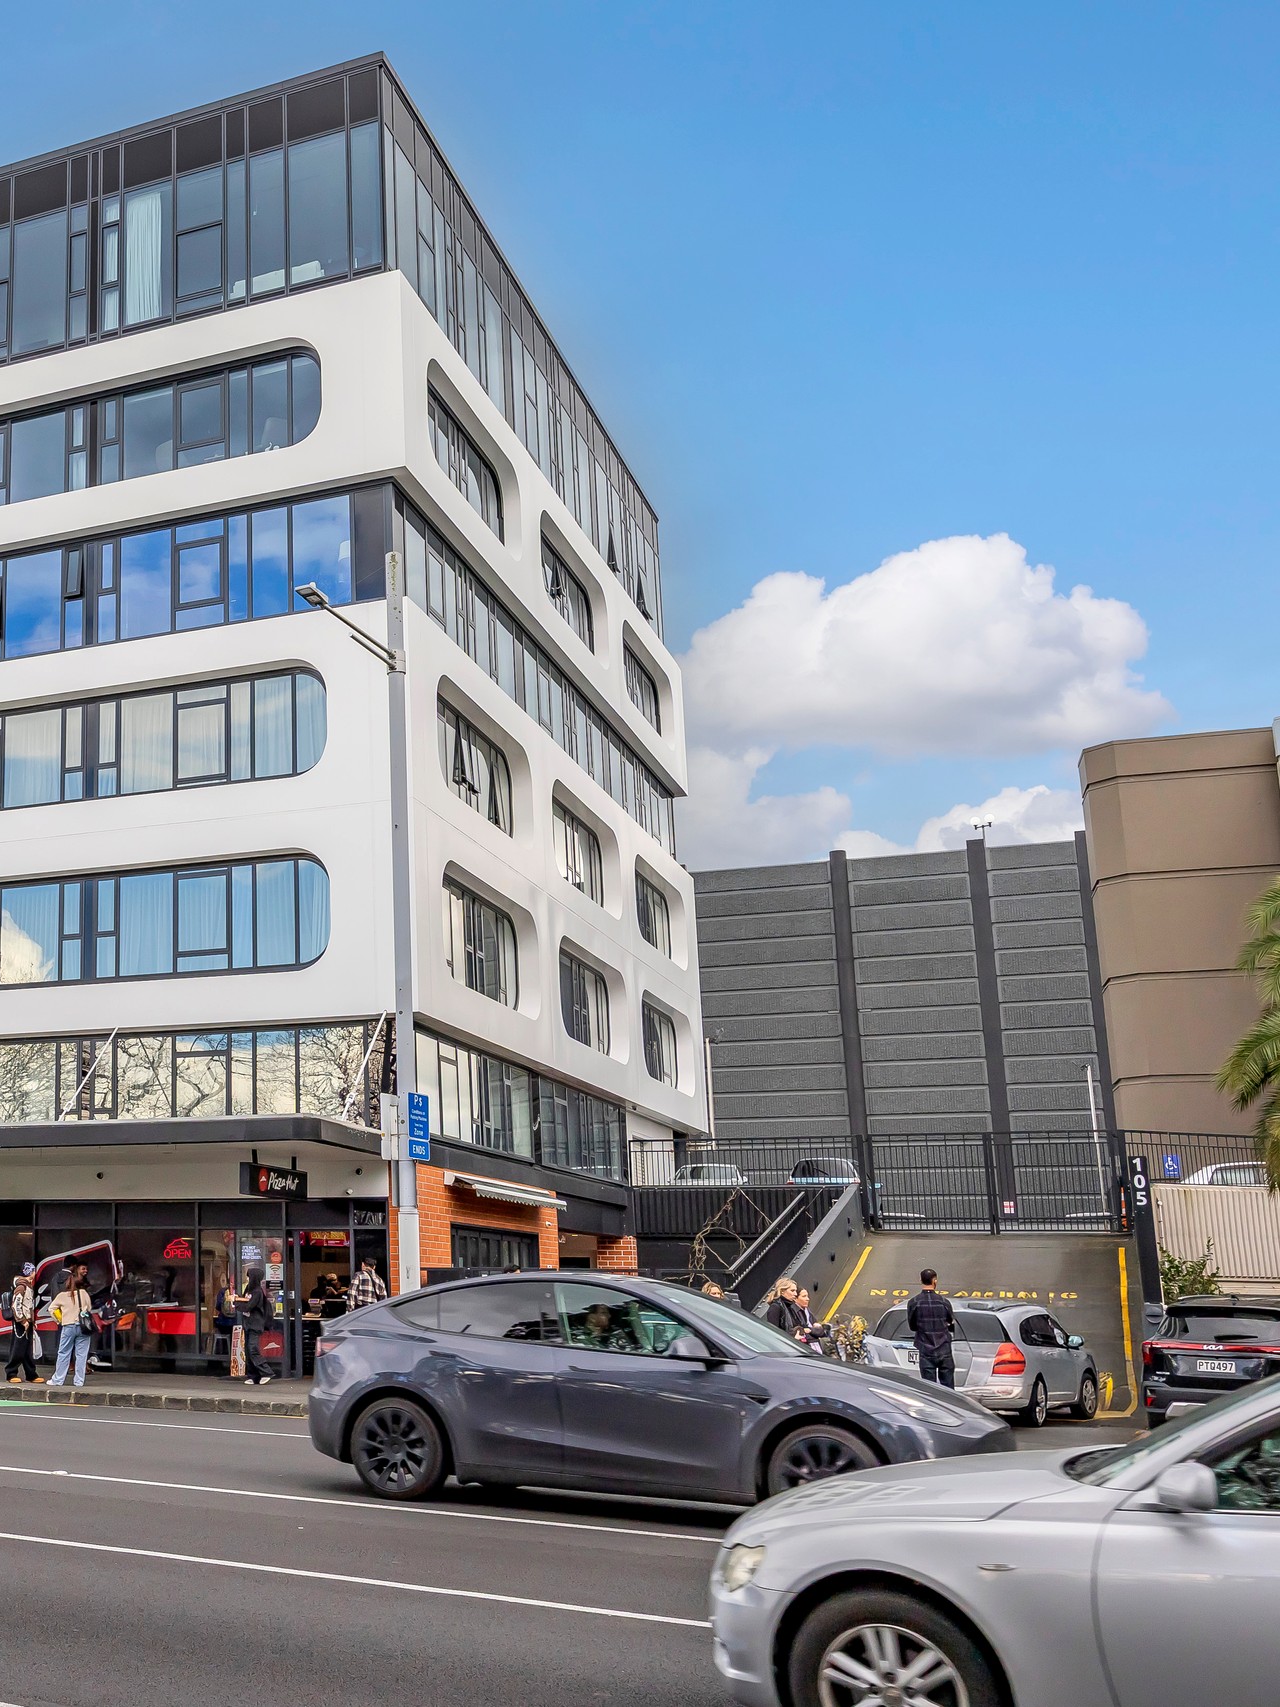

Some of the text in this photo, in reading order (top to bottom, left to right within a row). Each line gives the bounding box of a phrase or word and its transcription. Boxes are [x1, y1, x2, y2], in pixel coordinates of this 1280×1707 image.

[414, 1128, 424, 1136] Zone
[413, 1145, 425, 1155] ENDS
[267, 1171, 299, 1191] Pizza Hut
[1132, 1157, 1147, 1206] 105
[163, 1249, 191, 1259] OPEN
[869, 1289, 909, 1297] NO
[1198, 1361, 1234, 1372] PTQ497
